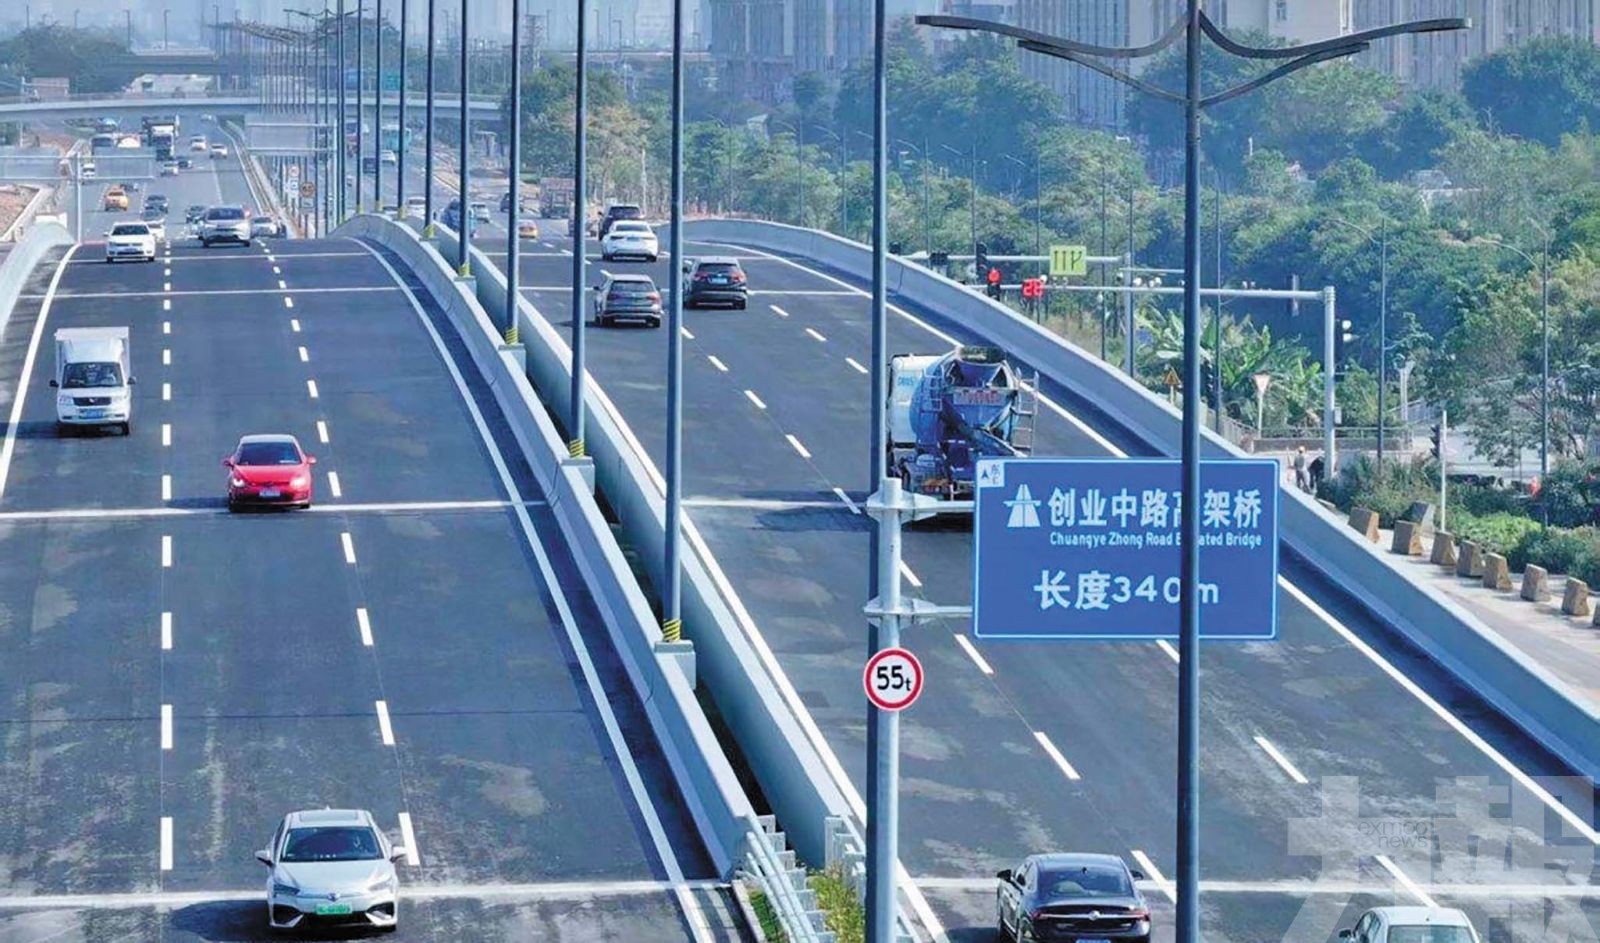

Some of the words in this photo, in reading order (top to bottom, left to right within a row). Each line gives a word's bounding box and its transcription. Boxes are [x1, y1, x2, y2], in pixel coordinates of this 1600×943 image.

[1050, 532, 1106, 549] Chuangye
[1109, 532, 1142, 549] Zhong
[1147, 532, 1172, 546] Road
[1176, 532, 1223, 546] Eated
[1226, 532, 1262, 549] Bridge
[877, 665, 911, 691] 55t
